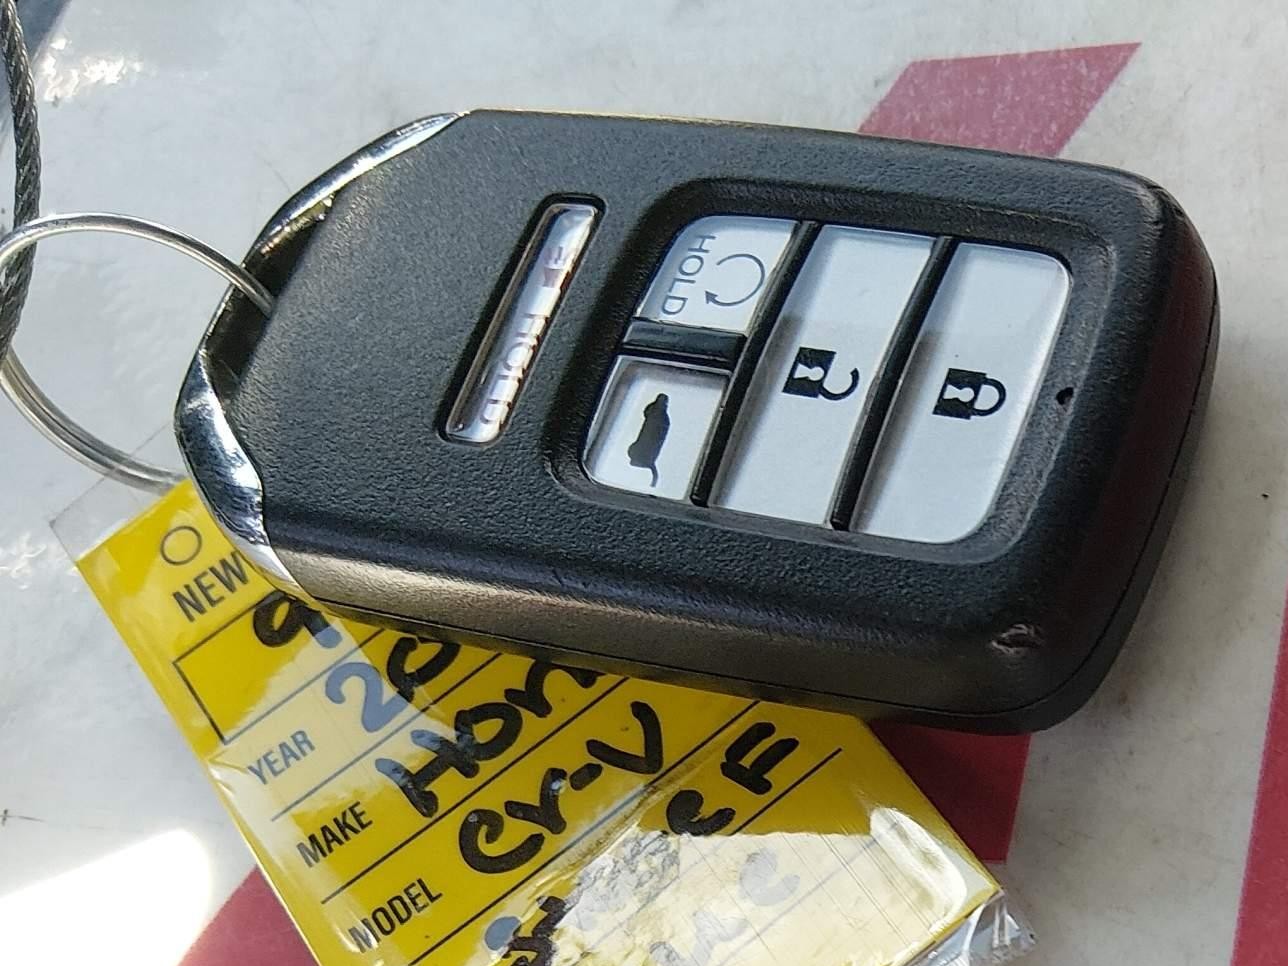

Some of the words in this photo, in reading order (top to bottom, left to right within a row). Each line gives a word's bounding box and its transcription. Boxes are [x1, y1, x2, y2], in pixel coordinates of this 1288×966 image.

[662, 235, 716, 315] HOLD
[172, 551, 250, 622] NEW
[247, 730, 316, 785] YEAR
[297, 801, 373, 868] MAKE
[348, 878, 442, 953] MODEL
